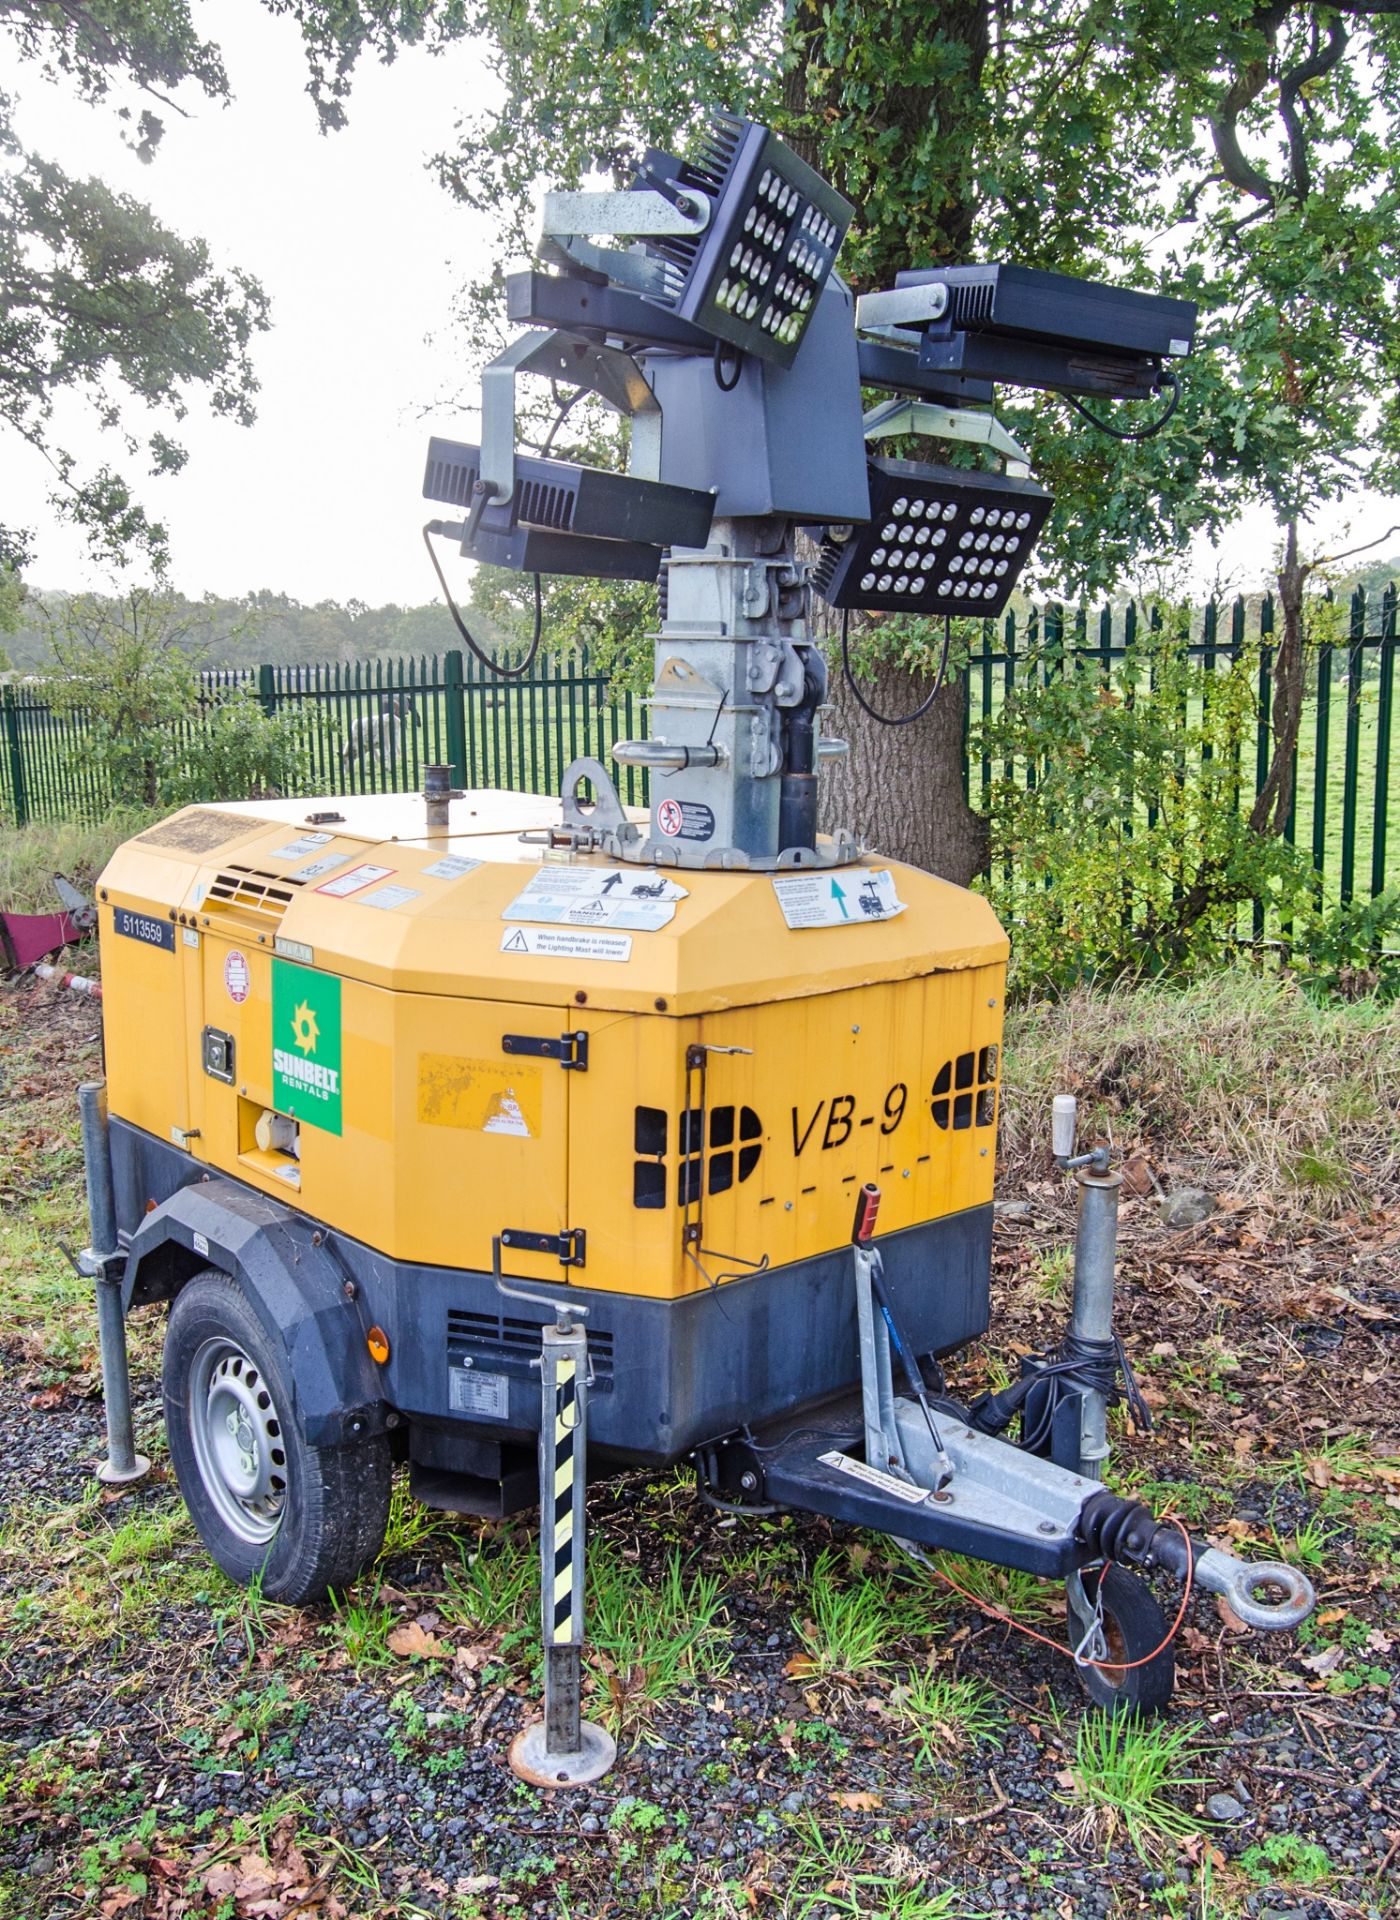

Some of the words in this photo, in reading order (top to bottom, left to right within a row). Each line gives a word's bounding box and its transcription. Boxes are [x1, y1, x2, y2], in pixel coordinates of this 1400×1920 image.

[123, 914, 162, 943] 5113559
[537, 933, 555, 941] When
[556, 935, 590, 944] handbrake
[598, 938, 627, 947] released
[547, 943, 574, 953] Lighting
[575, 946, 592, 954] Mast
[273, 1048, 339, 1095] SUNBELT
[281, 1074, 329, 1101] RENTALS
[791, 1083, 908, 1157] VB-9
